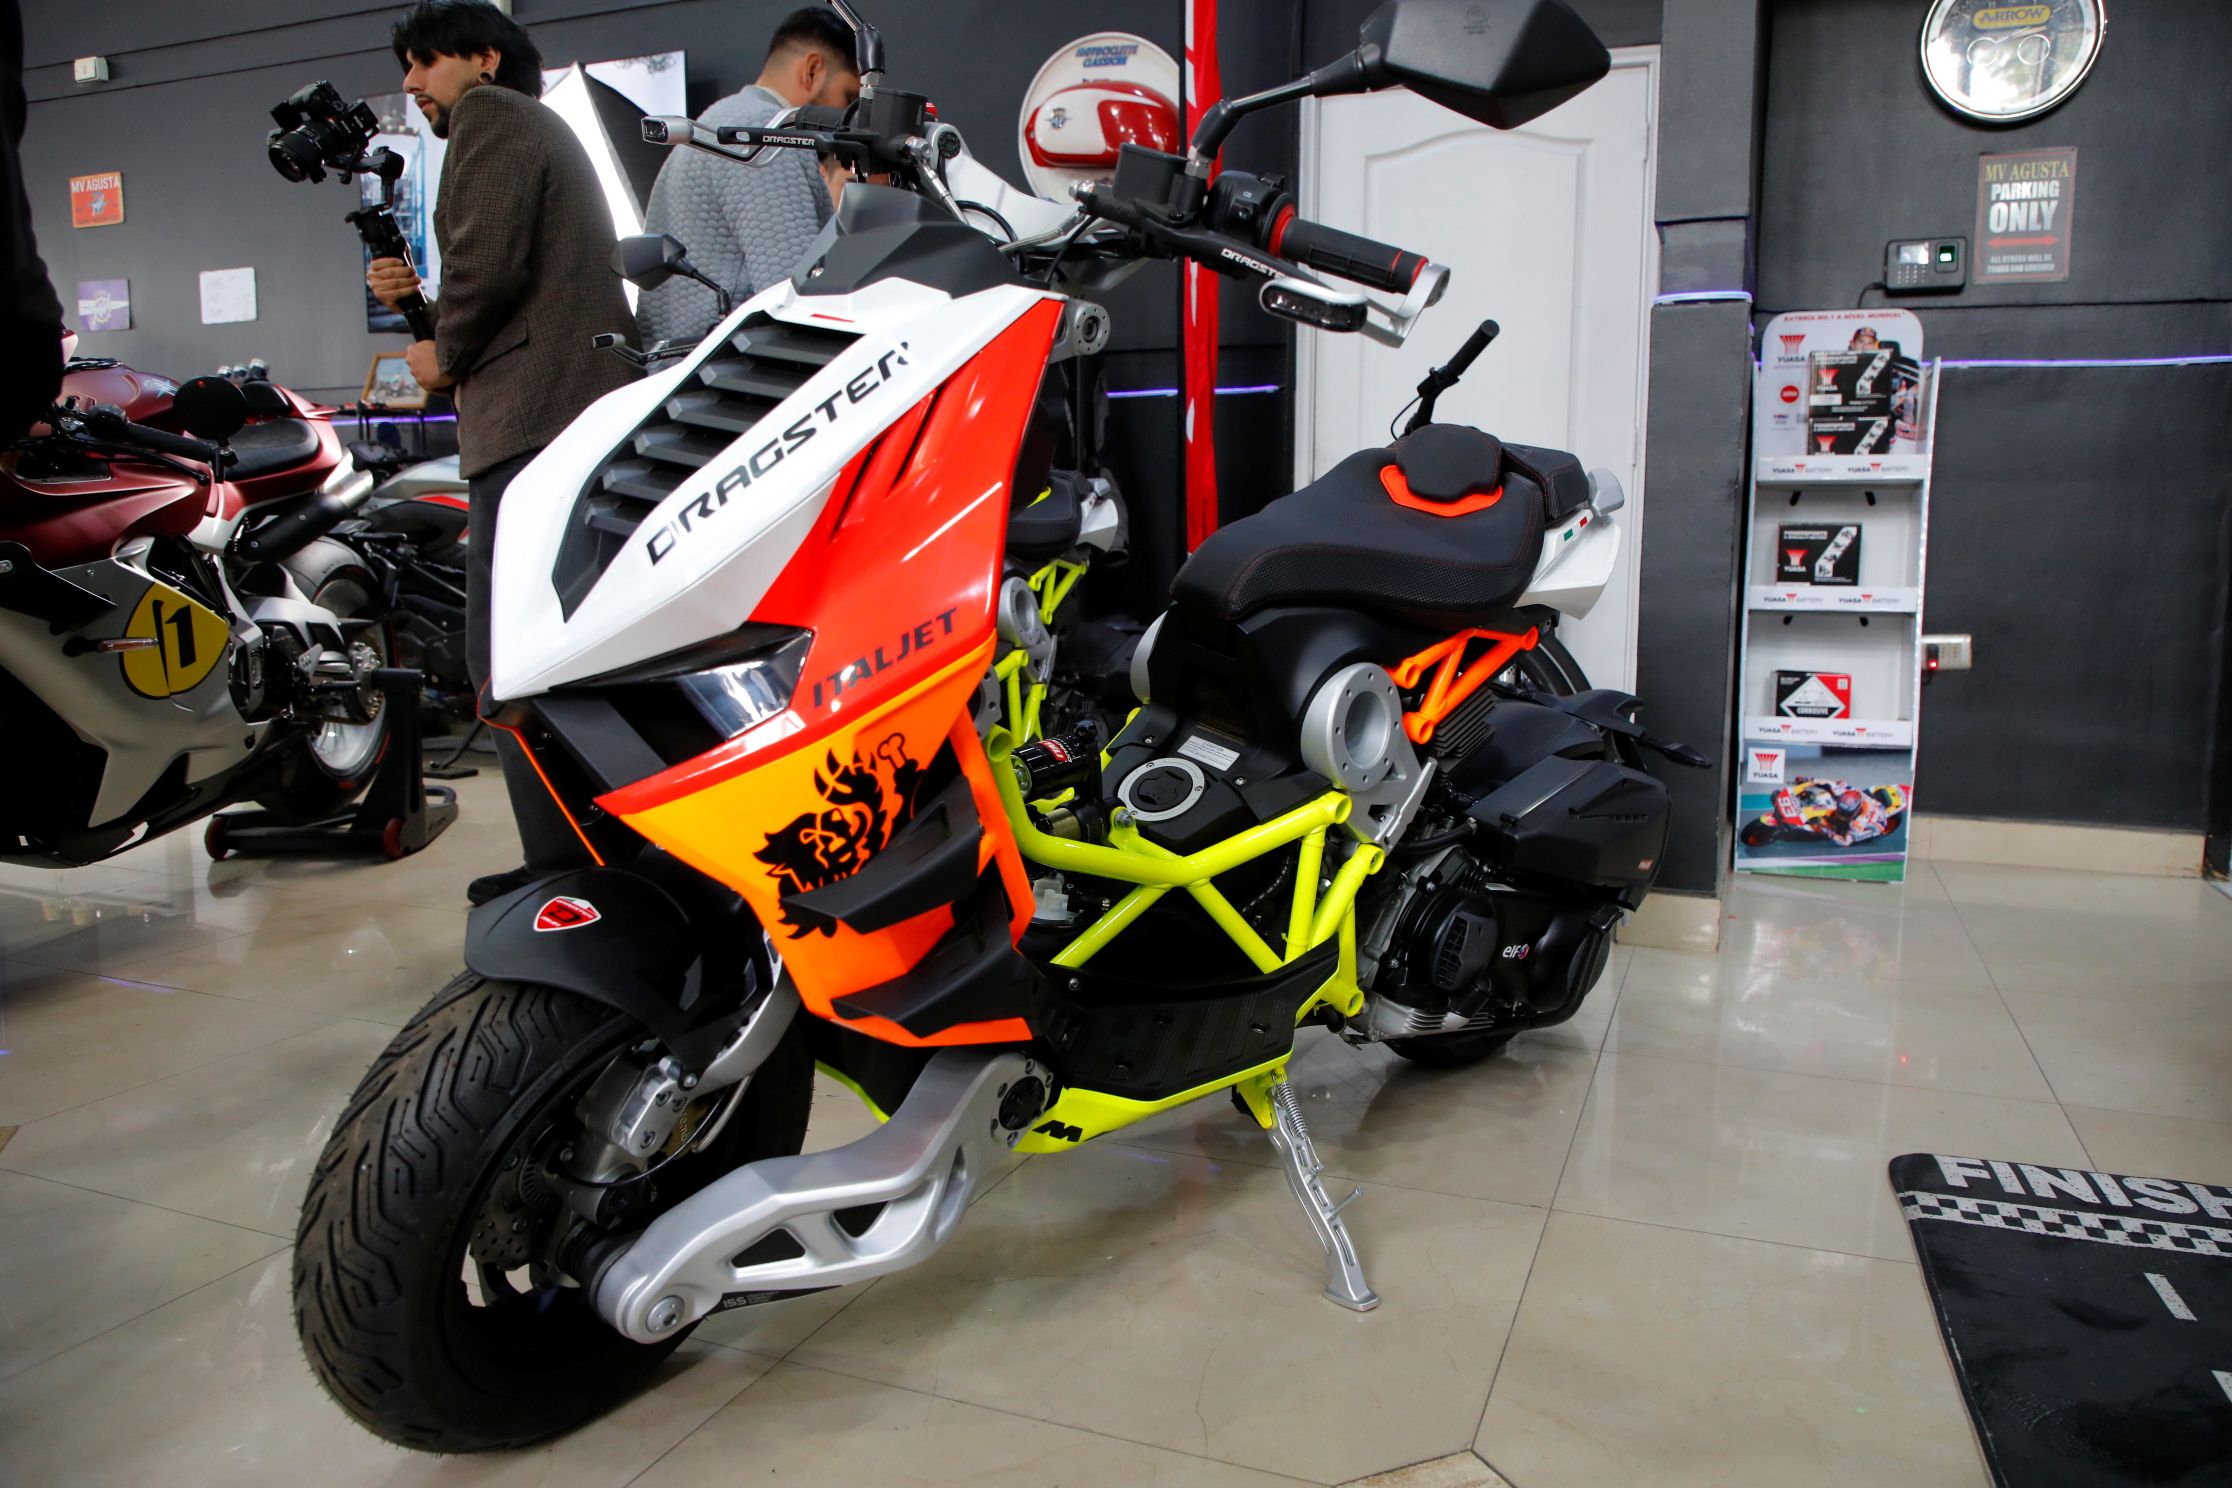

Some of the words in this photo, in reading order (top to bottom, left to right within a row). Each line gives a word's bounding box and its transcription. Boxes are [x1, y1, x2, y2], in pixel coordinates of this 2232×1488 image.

[1980, 8, 2045, 24] ARROW
[762, 135, 815, 147] DRAGSTER
[1984, 163, 2007, 182] MV
[2010, 160, 2070, 181] AGUSTA
[71, 180, 86, 193] MV
[86, 175, 121, 192] AGUSTA
[1990, 180, 2061, 201] PARKING
[1988, 200, 2059, 233] ONLY
[1221, 248, 1286, 280] DRAGSTE
[1777, 355, 1806, 363] YUASA
[646, 342, 910, 566] DRAGSTER
[1783, 565, 1807, 573] YUASA
[813, 607, 957, 709] ITALJET
[1832, 730, 1856, 738] YUASA
[1753, 772, 1779, 780] YUASA
[1502, 944, 1521, 959] elf
